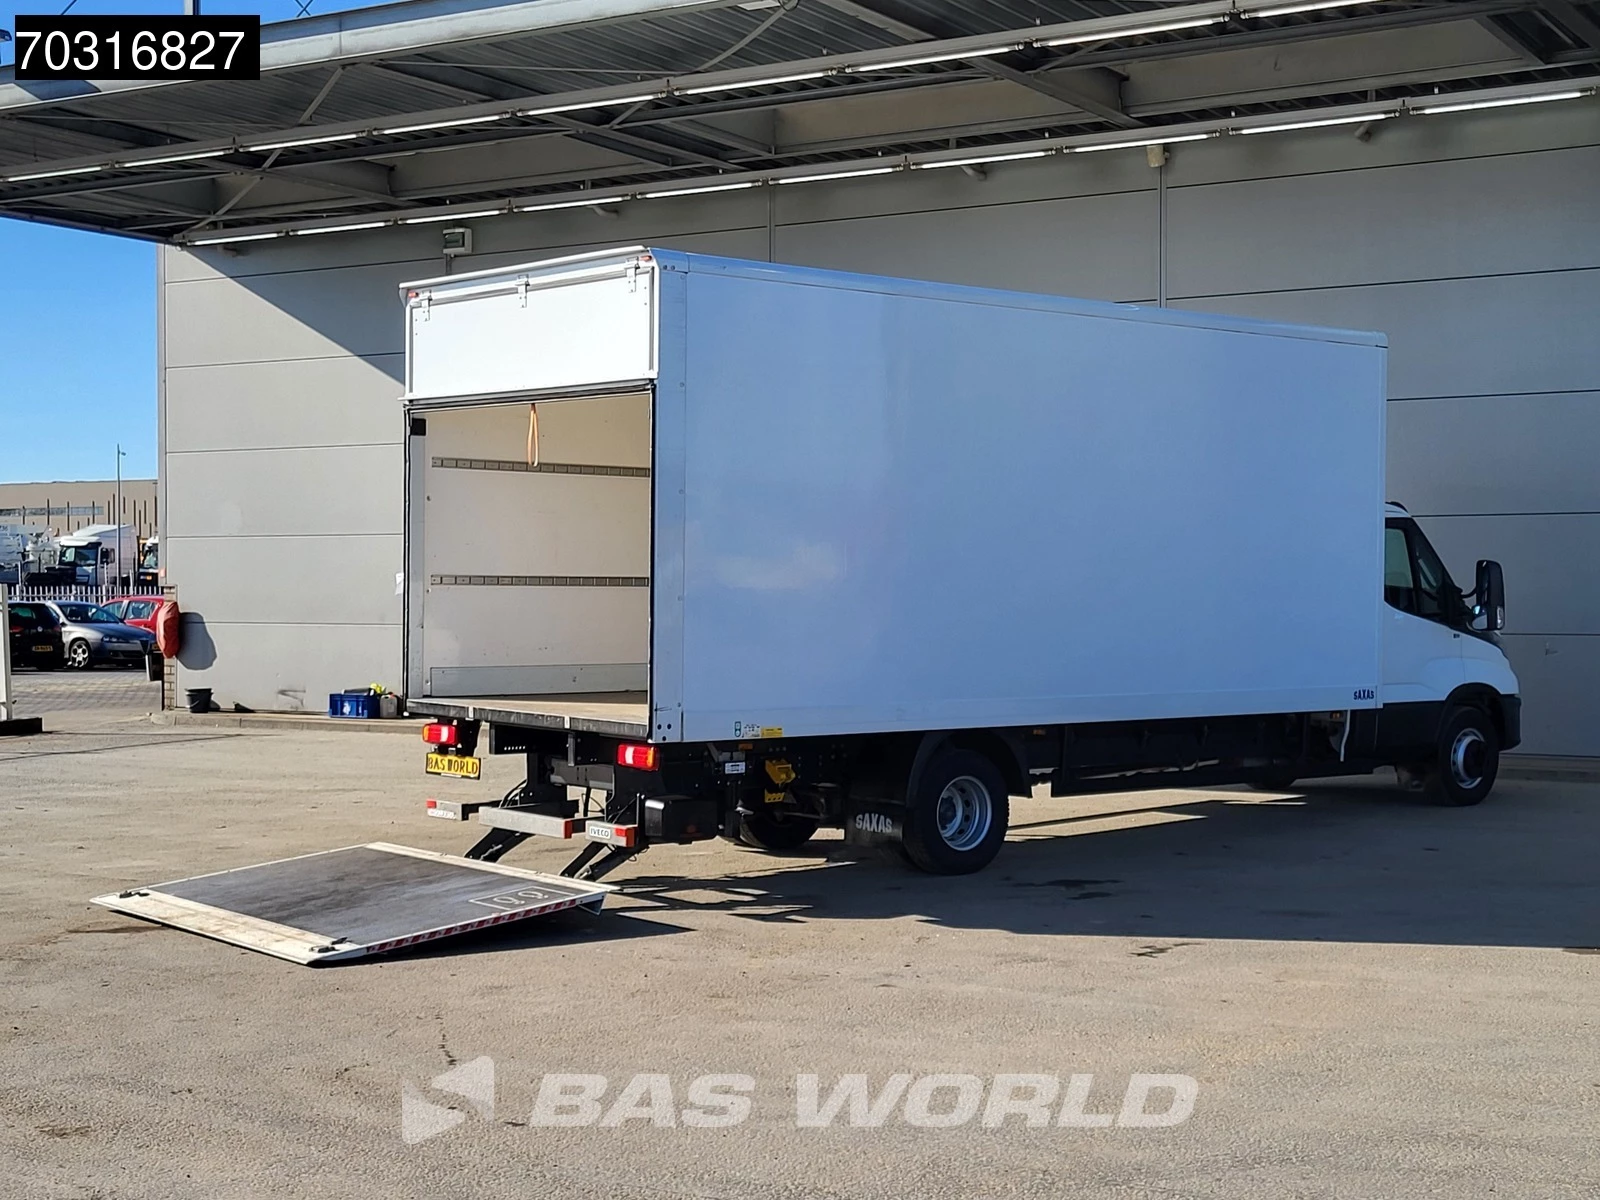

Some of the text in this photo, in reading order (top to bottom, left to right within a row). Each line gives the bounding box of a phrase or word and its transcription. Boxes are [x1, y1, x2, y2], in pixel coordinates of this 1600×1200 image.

[1353, 689, 1375, 701] SAXAS
[428, 756, 479, 775] BAS WORLD
[855, 812, 893, 833] SAXAS
[590, 827, 610, 838] IVECO
